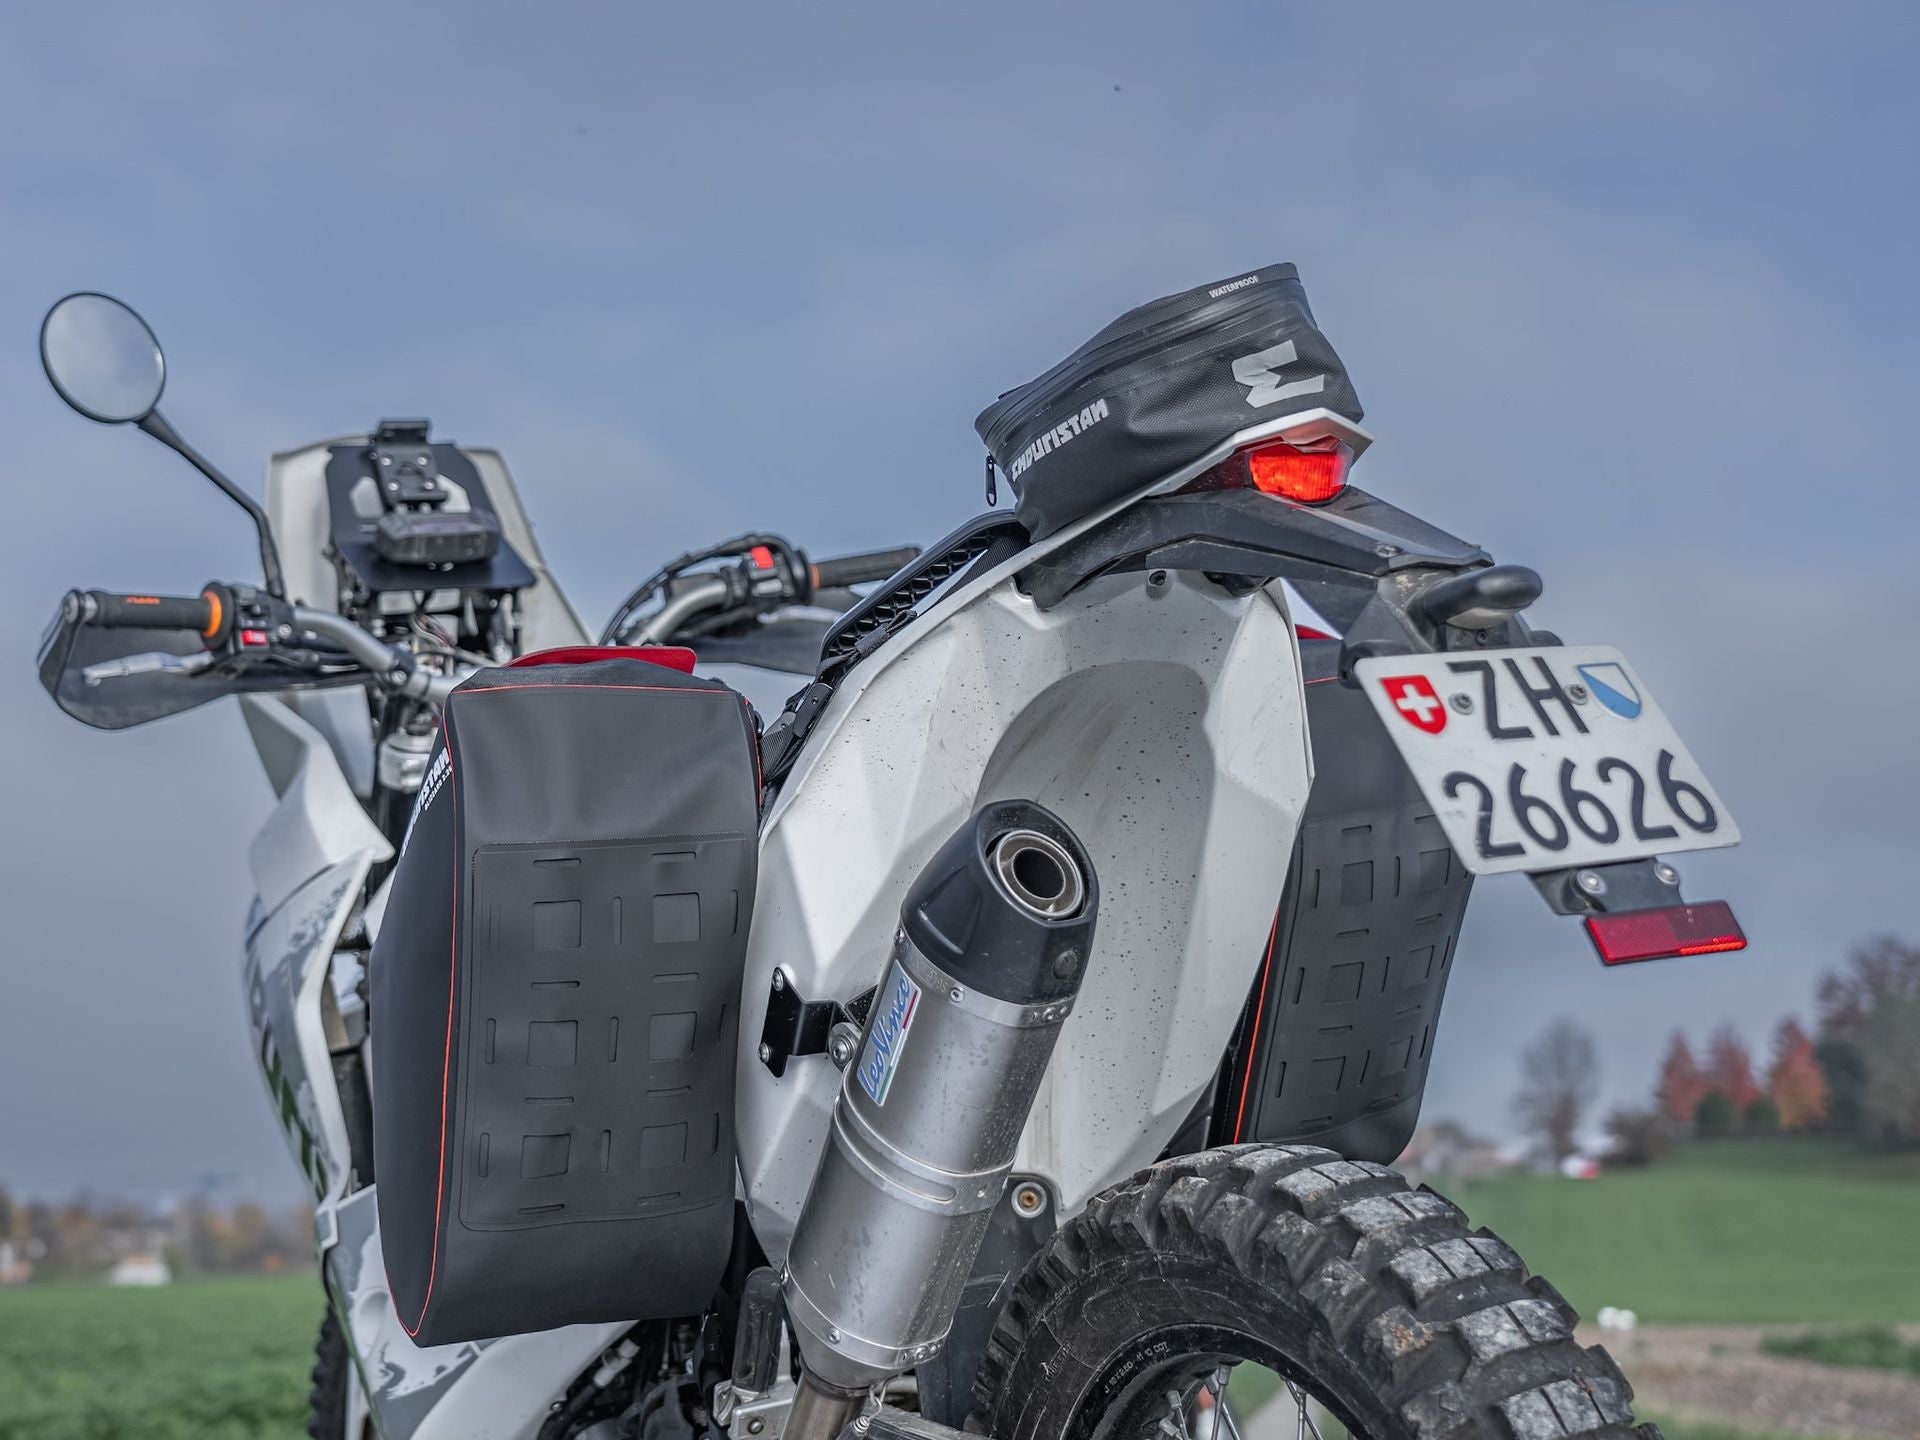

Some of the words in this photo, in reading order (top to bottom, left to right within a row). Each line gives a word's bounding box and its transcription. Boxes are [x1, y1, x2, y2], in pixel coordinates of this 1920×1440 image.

[1208, 275, 1259, 298] WATERPROOF
[1011, 398, 1109, 482] ENDURISTAN
[1446, 656, 1590, 740] ZH
[402, 746, 450, 858] ISTAN
[1441, 748, 1718, 859] 26626
[859, 976, 911, 1099] LeoVince
